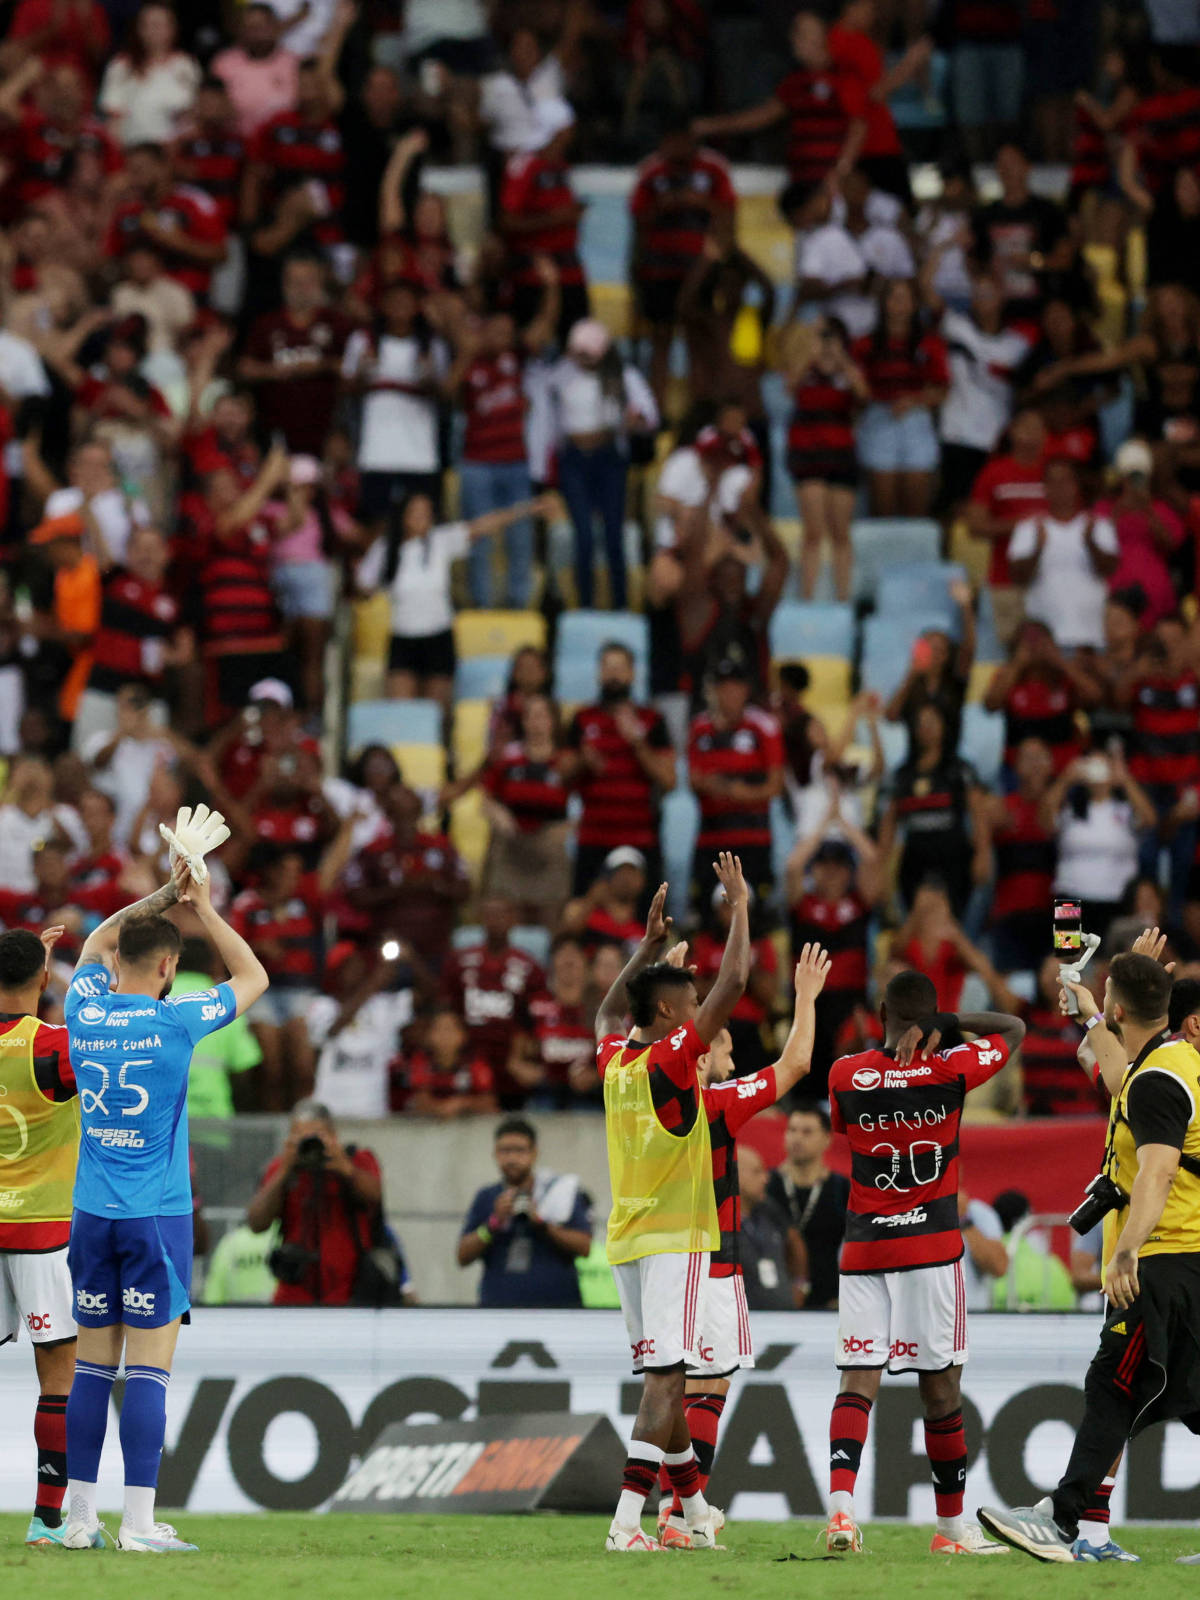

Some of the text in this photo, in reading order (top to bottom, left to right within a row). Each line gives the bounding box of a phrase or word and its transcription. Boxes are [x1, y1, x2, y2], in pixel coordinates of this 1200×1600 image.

[105, 1014, 129, 1026] livre
[111, 1007, 156, 1018] mercado
[72, 1034, 162, 1051] MATHEUS CUNHA
[885, 1066, 932, 1078] mercado
[80, 1060, 152, 1116] 25
[884, 1078, 908, 1088] livre
[87, 1126, 140, 1138] ASSIST
[101, 1137, 145, 1148] CARD
[871, 1140, 943, 1193] 20
[77, 1290, 108, 1309] abc
[123, 1287, 155, 1309] abc
[843, 1336, 873, 1353] abc
[889, 1339, 918, 1359] abc
